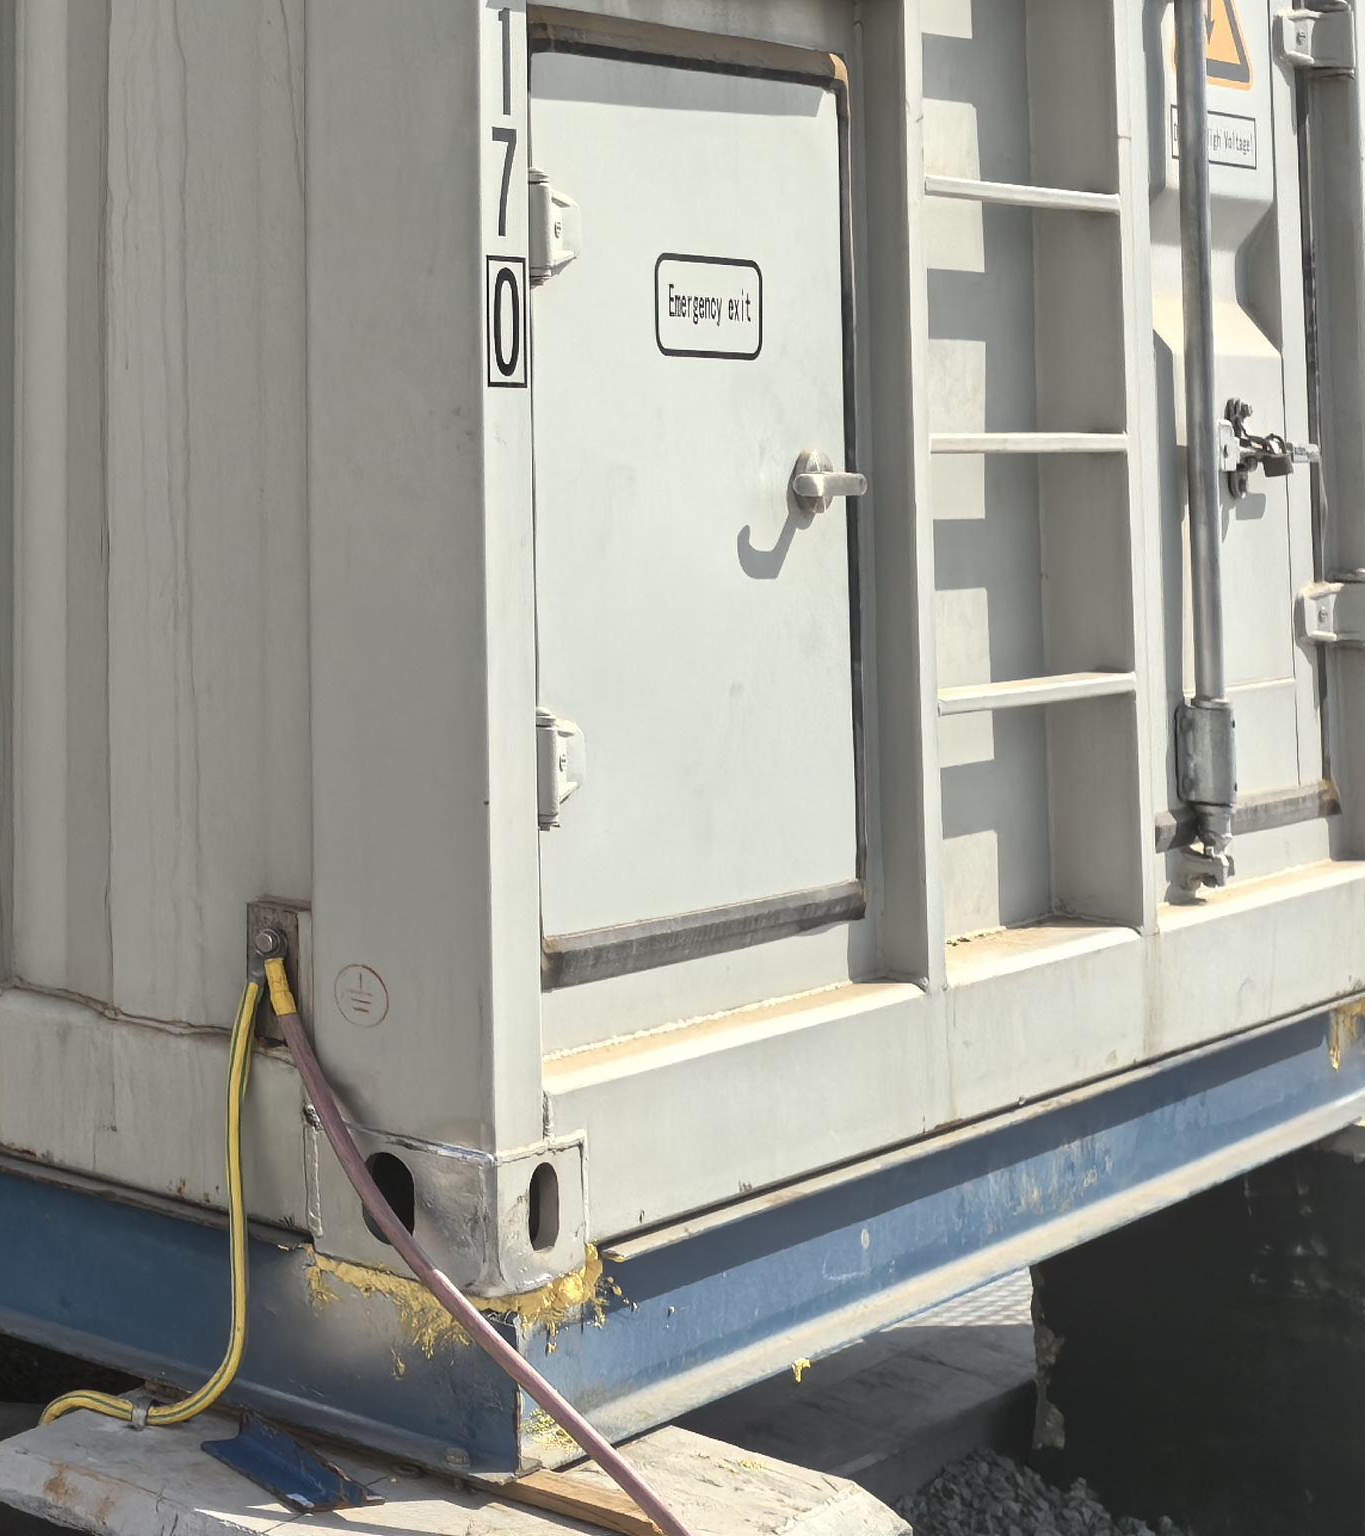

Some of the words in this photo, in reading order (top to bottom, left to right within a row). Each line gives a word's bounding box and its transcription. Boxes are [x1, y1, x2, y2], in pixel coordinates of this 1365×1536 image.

[493, 266, 520, 378] 0
[668, 283, 722, 326] Emergency
[728, 288, 751, 322] exit
